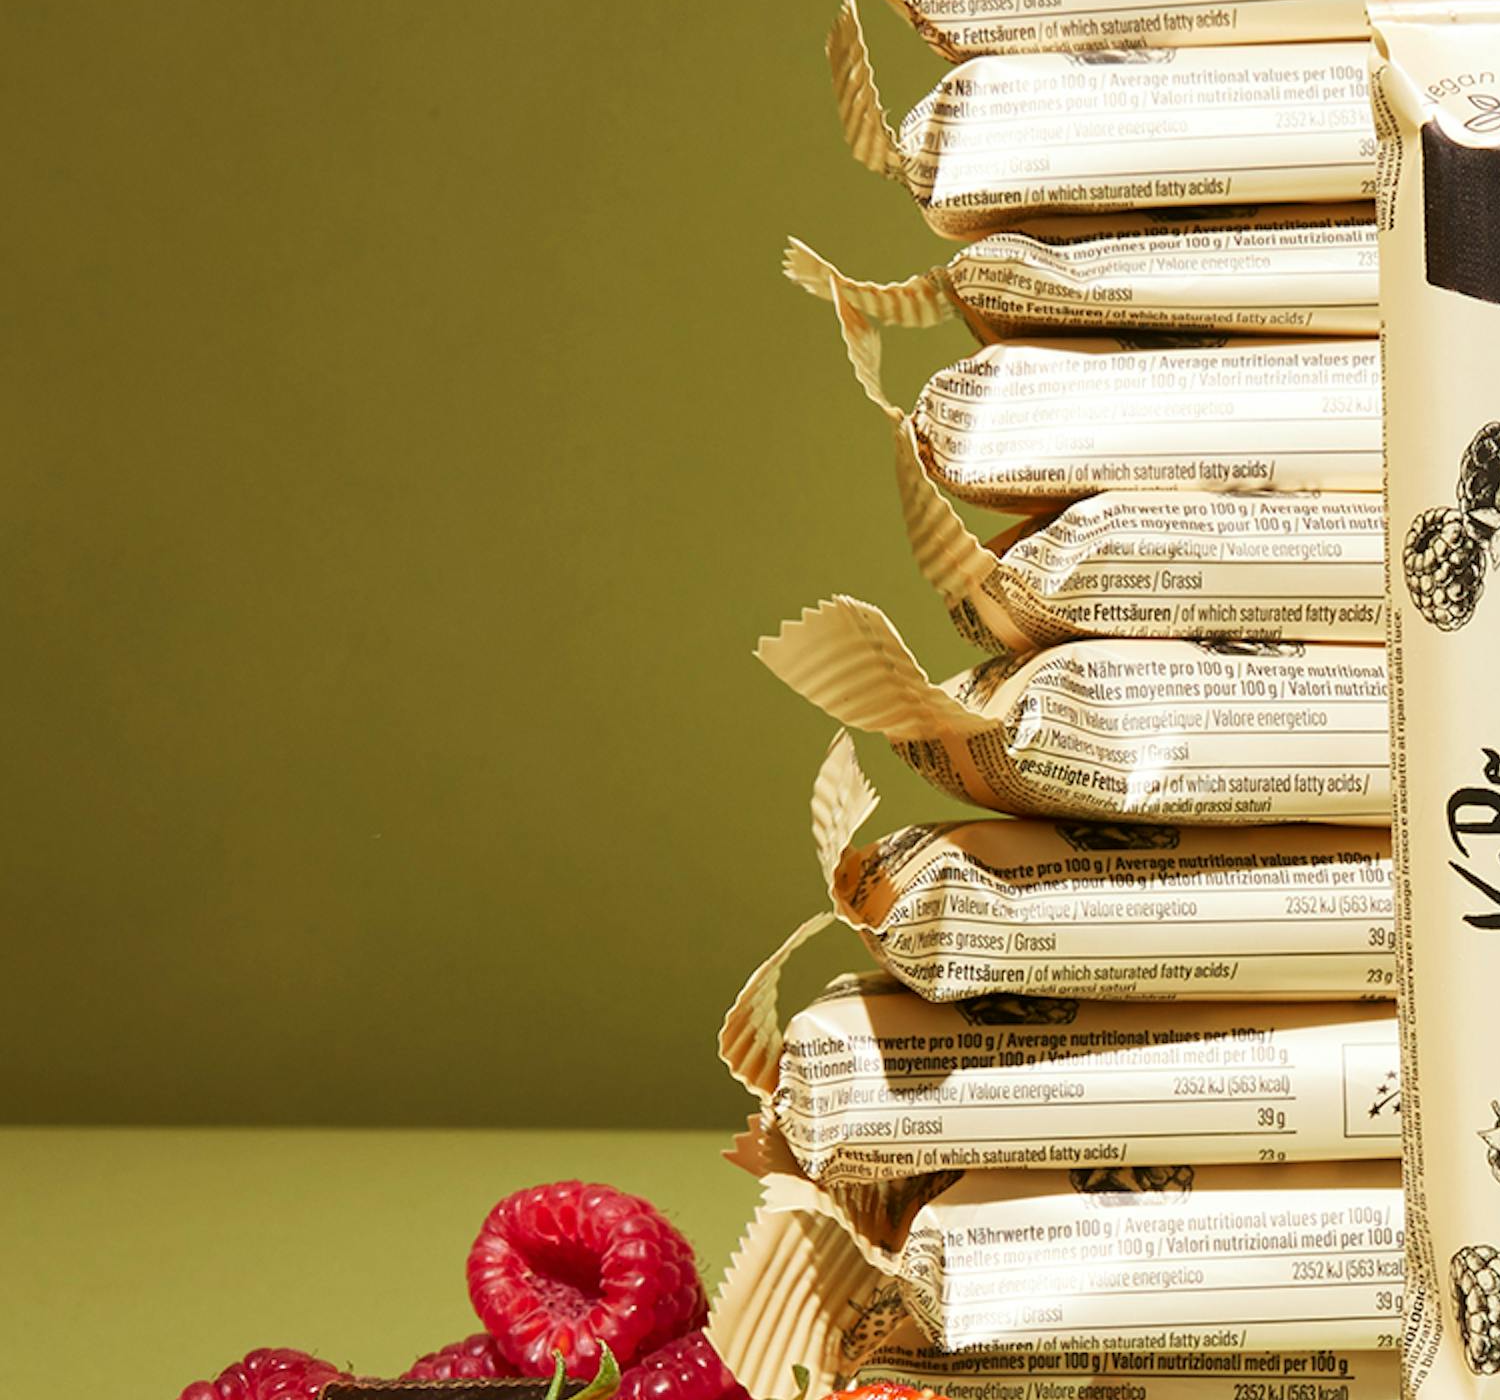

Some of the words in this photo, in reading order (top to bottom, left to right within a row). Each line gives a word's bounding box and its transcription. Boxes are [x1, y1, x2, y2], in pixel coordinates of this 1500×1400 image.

[964, 25, 1036, 44] Fettsäuren
[1059, 18, 1097, 36] which
[1100, 13, 1160, 33] saturated
[1163, 13, 1193, 32] fatty
[1196, 9, 1230, 28] acids
[1048, 184, 1086, 202] which
[1090, 178, 1152, 200] saturated
[1155, 178, 1185, 198] fatty
[1188, 177, 1224, 195] acids
[1149, 239, 1180, 253] pour
[1187, 236, 1210, 249] 100
[1234, 233, 1275, 247] Valori
[1280, 230, 1361, 245] nutrizionali
[1026, 302, 1102, 317] Fettsäuren
[1128, 309, 1168, 321] which
[1171, 311, 1233, 323] saturated
[1236, 311, 1266, 325] fatty
[1269, 311, 1304, 324] acids
[1091, 463, 1130, 481] which
[1133, 461, 1196, 480] saturated
[1199, 461, 1230, 482] fatty
[1232, 460, 1268, 479] acids
[1139, 540, 1217, 560] énergétique
[1226, 543, 1270, 557] Valore
[1272, 541, 1342, 560] energetico
[1101, 572, 1151, 592] grasses
[1161, 570, 1202, 590] Grassi
[1094, 603, 1171, 621] Fettsäuren
[1181, 603, 1196, 620] of
[1198, 603, 1237, 620] which
[1240, 603, 1302, 621] saturated
[1306, 603, 1337, 625] fatty
[1340, 603, 1374, 620] acids
[1088, 661, 1167, 679] Nährwerte
[1170, 664, 1194, 679] pro
[1198, 661, 1221, 676] 100
[1246, 663, 1304, 680] Average
[1307, 664, 1385, 679] nutritional
[1126, 683, 1201, 700] moyennes
[1203, 682, 1237, 699] pour
[1241, 681, 1266, 695] 100
[1288, 681, 1332, 696] Valori
[1020, 759, 1090, 787] gesättigte
[1186, 775, 1225, 793] which
[1228, 774, 1291, 793] saturated
[1294, 773, 1324, 796] fatty
[1327, 773, 1362, 793] acids
[950, 895, 989, 915] Valeur
[1080, 901, 1123, 918] Valore
[1126, 899, 1198, 919] energetico
[1285, 896, 1317, 914] 2352
[1320, 896, 1336, 914] kJ
[1340, 896, 1368, 916] (563
[956, 931, 1004, 950] grasses
[1014, 932, 1056, 951] Grassi
[1368, 927, 1385, 946] 39
[947, 961, 1024, 982] Fettsäuren
[1035, 964, 1051, 981] of
[1053, 964, 1091, 981] which
[1093, 962, 1157, 980] saturated
[1161, 962, 1191, 981] fatty
[1194, 961, 1229, 979] acids
[1367, 969, 1381, 983] 23
[968, 1083, 1010, 1100] Valore
[1013, 1080, 1084, 1102] energetico
[1173, 1076, 1205, 1096] 2352
[1207, 1076, 1224, 1095] kJ
[1227, 1075, 1257, 1096] (563
[1260, 1074, 1290, 1095] kcal)
[841, 1120, 892, 1140] grasses
[902, 1115, 943, 1136] Grassi
[1257, 1107, 1274, 1126] 39
[1277, 1110, 1286, 1129] g
[967, 1226, 1045, 1245] Nährwerte
[1047, 1224, 1073, 1240] pro
[1075, 1218, 1101, 1237] 100
[1125, 1217, 1184, 1235] Average
[1188, 1212, 1267, 1231] nutritional
[1270, 1210, 1318, 1227] values
[1321, 1210, 1344, 1228] per
[1348, 1206, 1382, 1226] 100g
[1168, 1235, 1209, 1253] Valori
[1213, 1231, 1297, 1252] nutrizionali
[1301, 1229, 1337, 1247] medi
[1341, 1231, 1364, 1249] per
[1368, 1228, 1392, 1245] 100
[951, 1355, 1025, 1372] moyennes
[1028, 1355, 1060, 1372] pour
[1065, 1352, 1089, 1369] 100
[1112, 1352, 1154, 1370] Valori
[1158, 1352, 1241, 1371] nutrizionali
[1244, 1350, 1280, 1371] medi
[1283, 1356, 1307, 1374] per
[1310, 1353, 1336, 1372] 100
[945, 1382, 1024, 1400] énergétique
[1034, 1383, 1074, 1399] Valore
